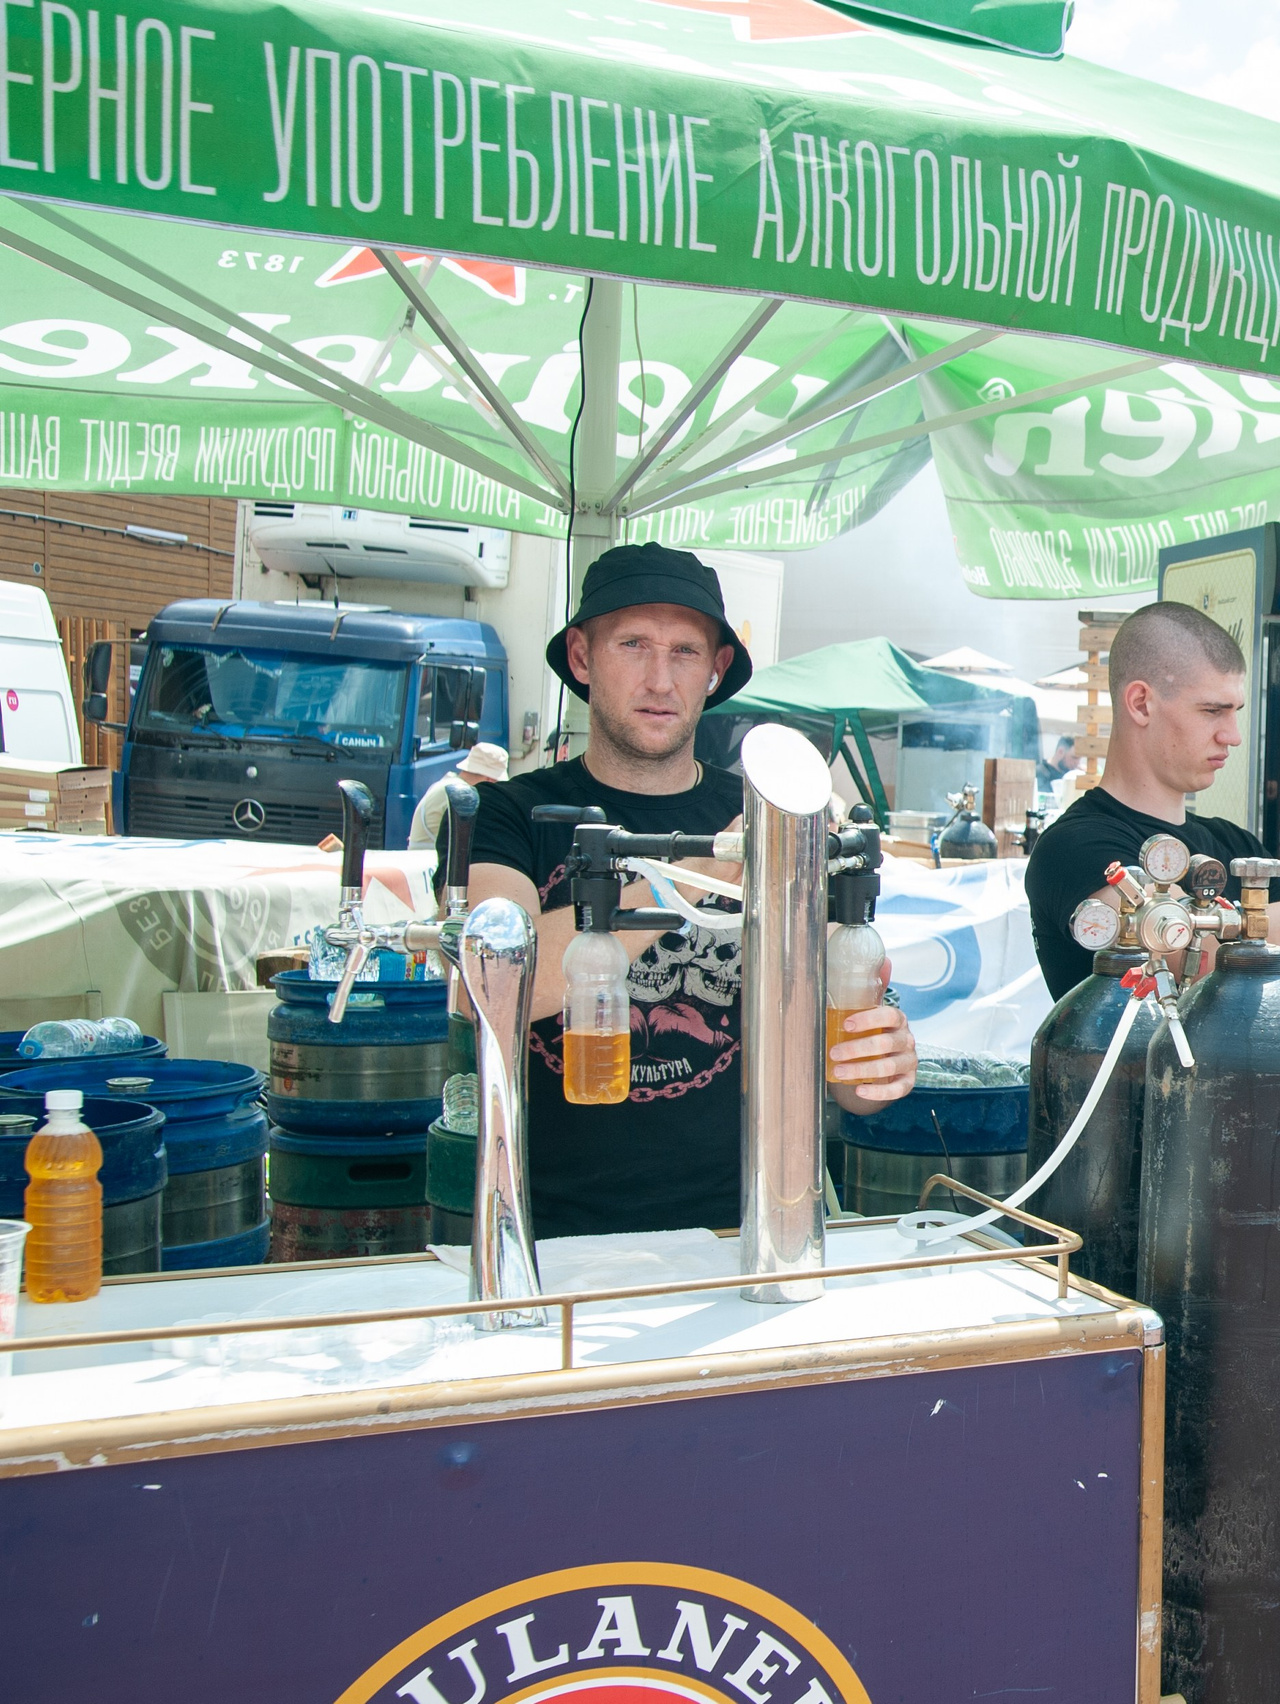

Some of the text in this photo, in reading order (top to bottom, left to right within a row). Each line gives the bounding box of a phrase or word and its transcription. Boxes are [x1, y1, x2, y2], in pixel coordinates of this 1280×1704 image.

[262, 41, 718, 254] УПОТРЕБЛЕНИЕ
[752, 127, 1083, 307] АЛКОГОЛЬНОЙ
[342, 736, 376, 748] САНЫЧ
[631, 1057, 693, 1083] КУЛЬТУРА
